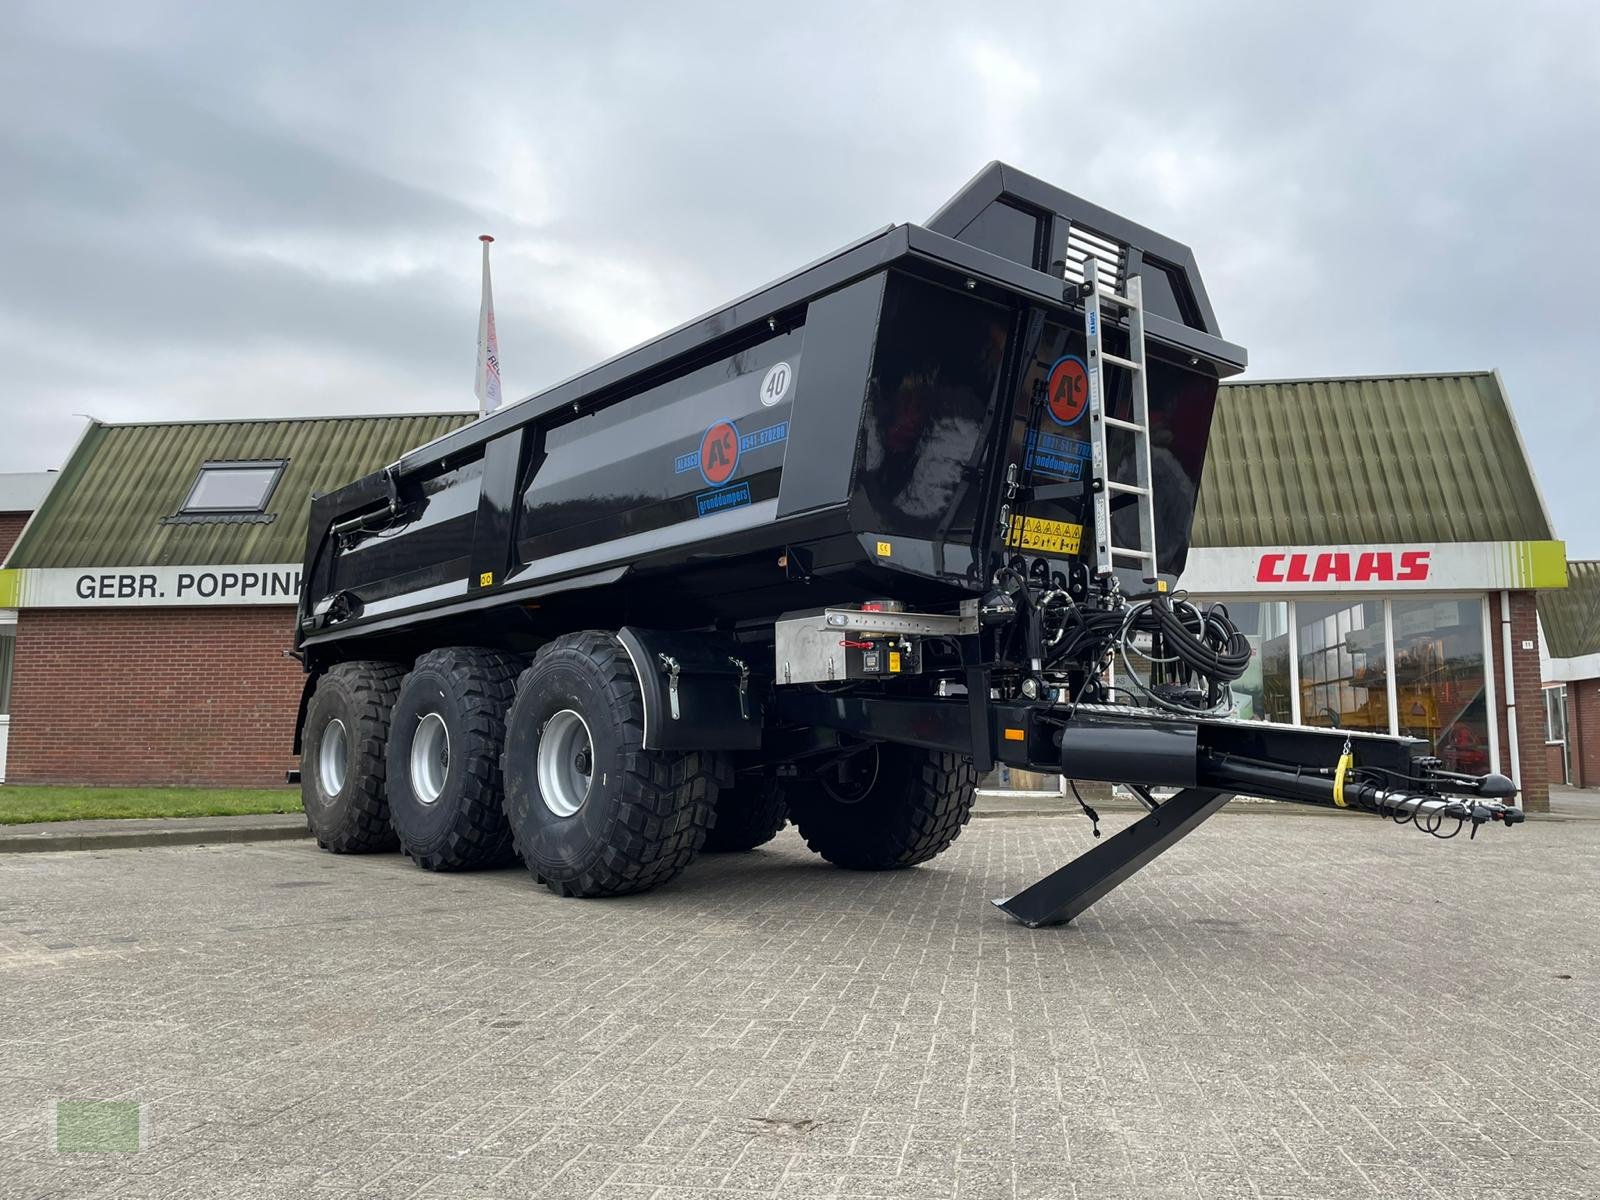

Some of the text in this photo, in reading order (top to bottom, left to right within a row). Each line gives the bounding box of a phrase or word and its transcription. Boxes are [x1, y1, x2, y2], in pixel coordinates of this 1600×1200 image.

[766, 369, 786, 398] 40
[1256, 551, 1431, 583] CLAAS
[76, 574, 165, 599] GEBR.
